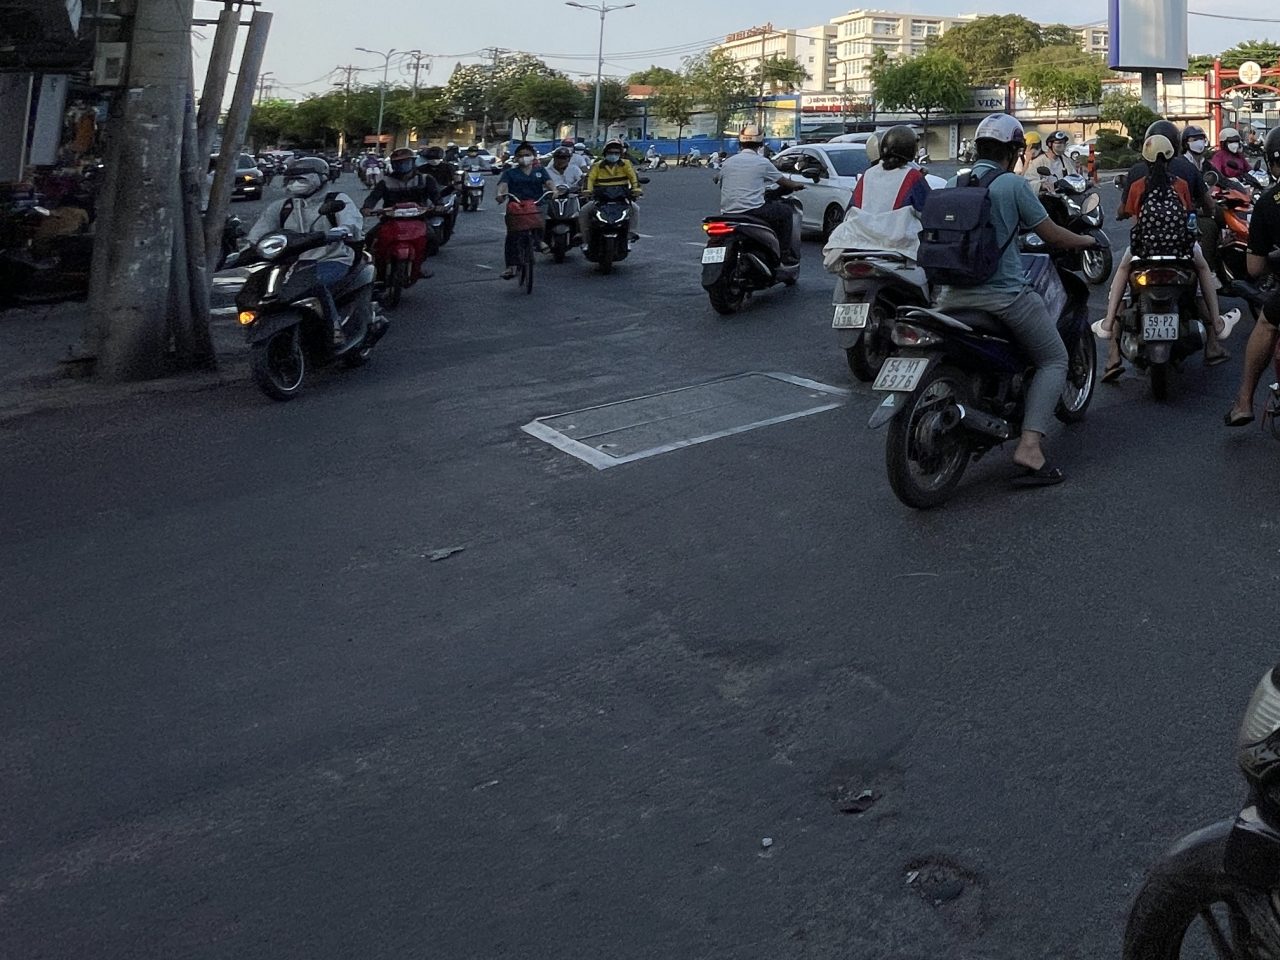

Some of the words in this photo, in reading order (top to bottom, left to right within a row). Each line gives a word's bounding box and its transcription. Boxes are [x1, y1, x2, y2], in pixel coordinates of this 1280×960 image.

[1148, 315, 1174, 327] 59-P2
[887, 360, 920, 374] 54-H1
[880, 374, 914, 389] 6976
